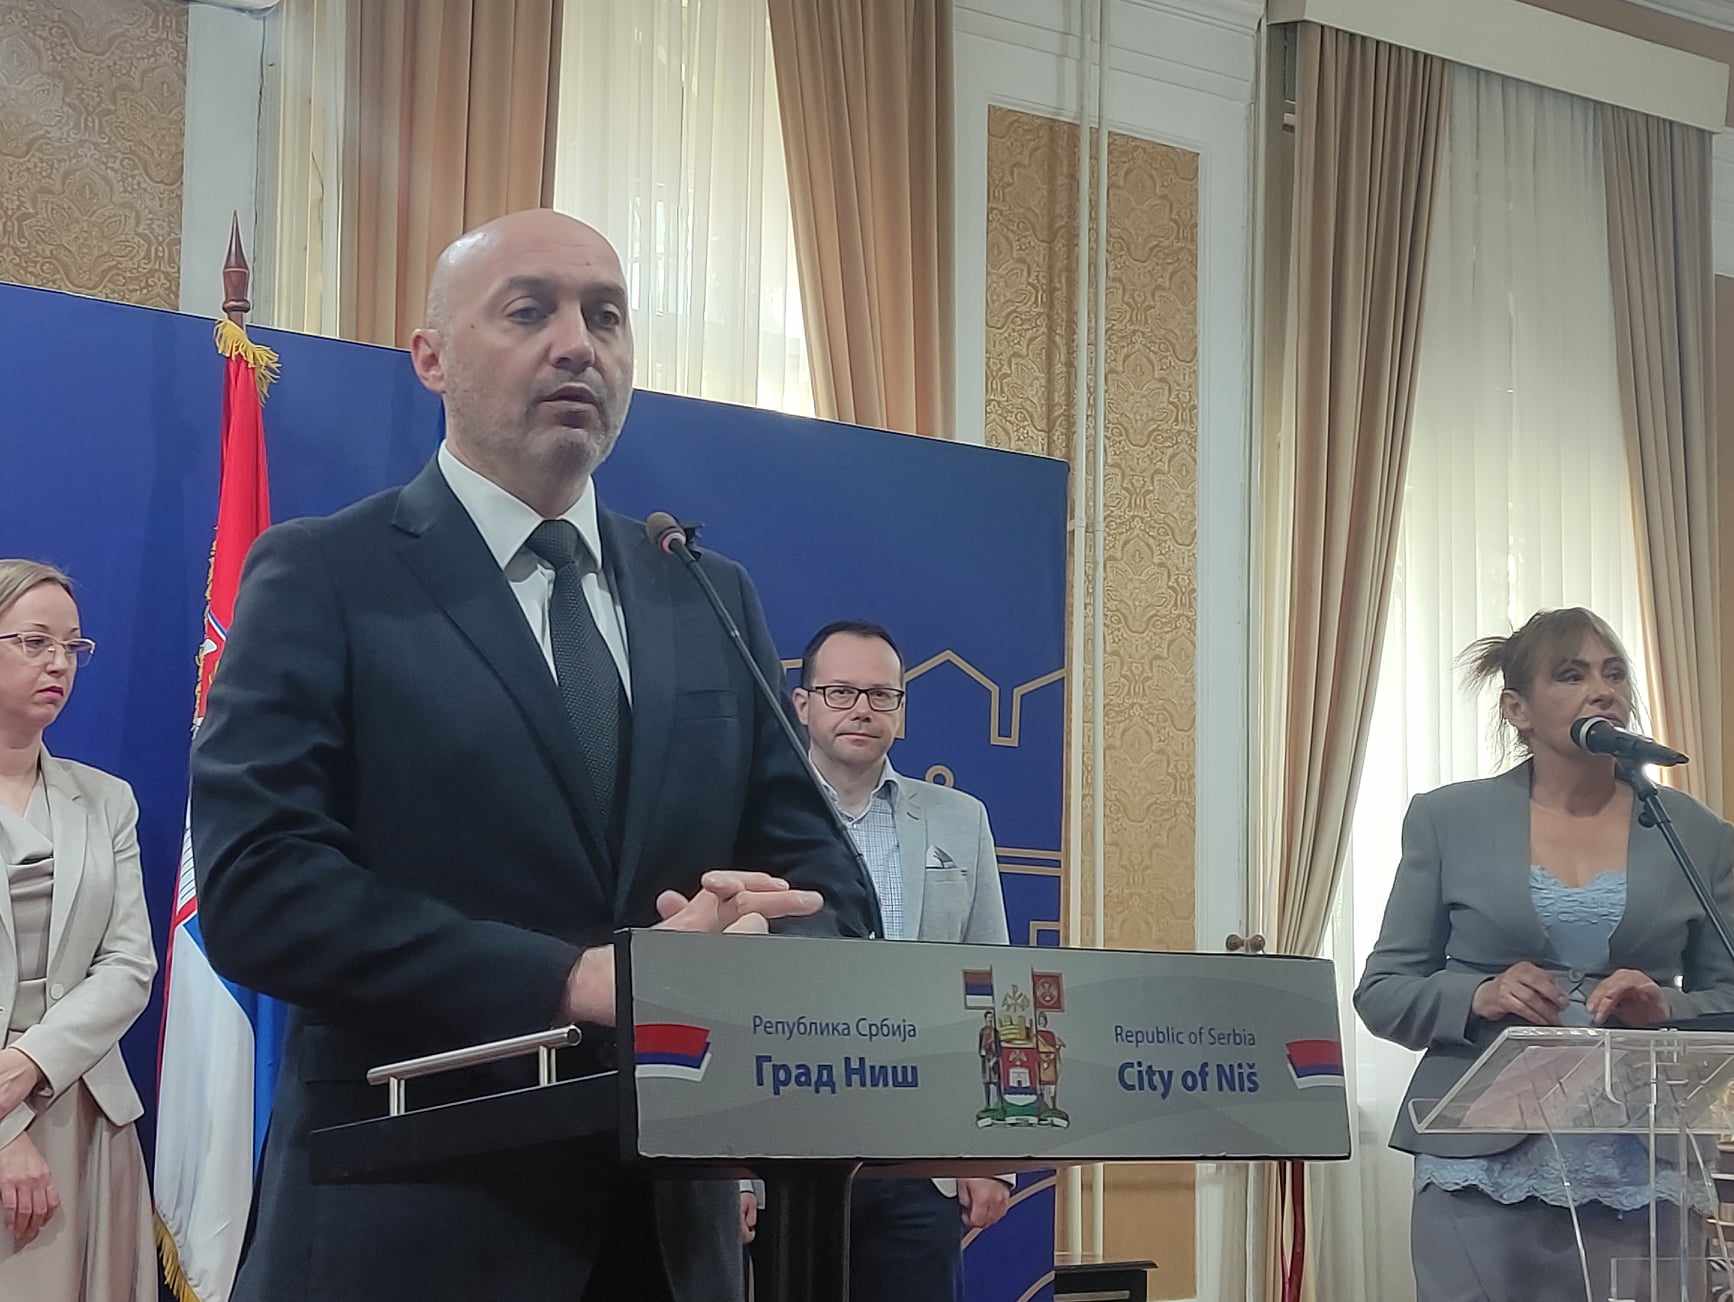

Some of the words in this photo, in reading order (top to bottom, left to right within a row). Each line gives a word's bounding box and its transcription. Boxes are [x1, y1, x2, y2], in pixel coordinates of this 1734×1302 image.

[753, 1015, 850, 1040] Република
[856, 1018, 917, 1042] Србија
[1115, 1025, 1184, 1047] Republic
[1188, 1027, 1204, 1045] of
[1208, 1028, 1256, 1046] Serbia
[755, 1055, 836, 1095] Град
[844, 1057, 919, 1088] Ниш
[1118, 1061, 1174, 1100] City
[1181, 1062, 1209, 1092] of
[1216, 1062, 1260, 1092] Niš
